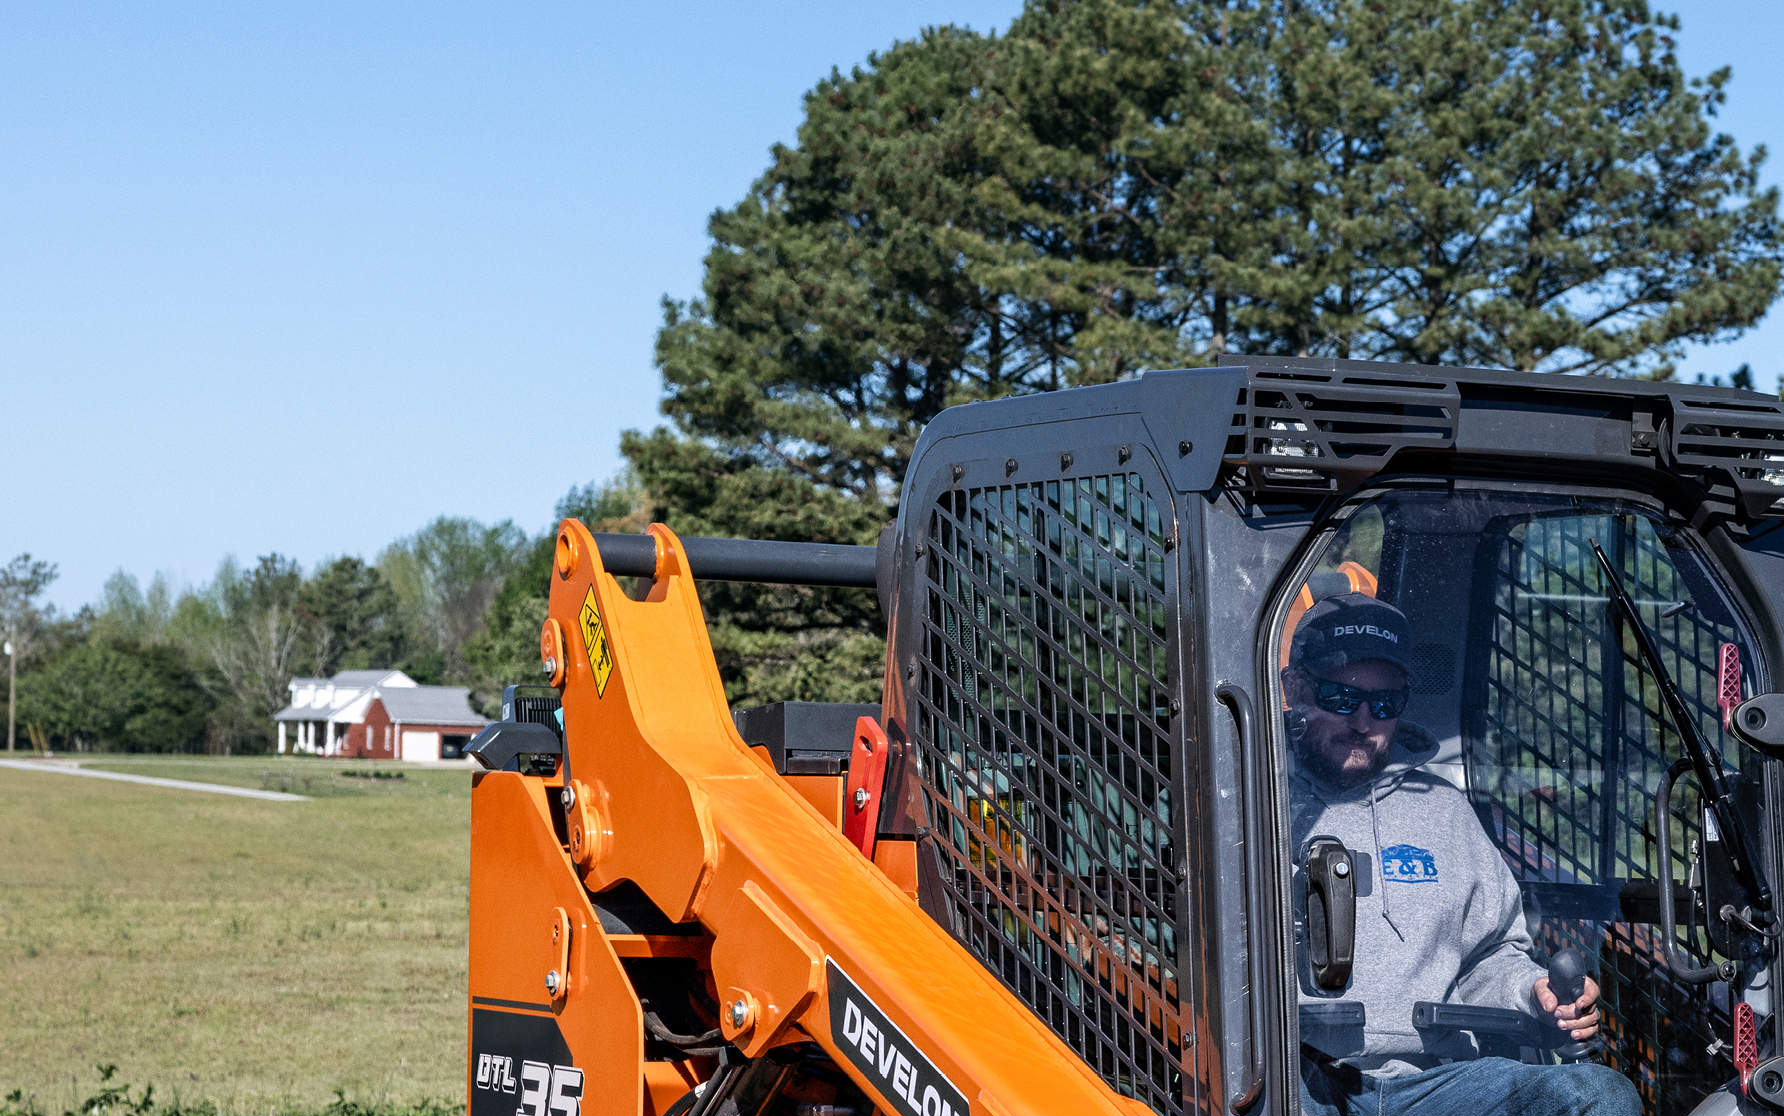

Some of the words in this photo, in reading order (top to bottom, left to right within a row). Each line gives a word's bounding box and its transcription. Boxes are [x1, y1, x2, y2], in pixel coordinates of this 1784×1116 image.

[1333, 625, 1398, 644] DEVELON
[1382, 859, 1395, 876] E
[1398, 859, 1418, 876] &
[1421, 859, 1438, 877] B
[476, 1053, 518, 1094] DTL
